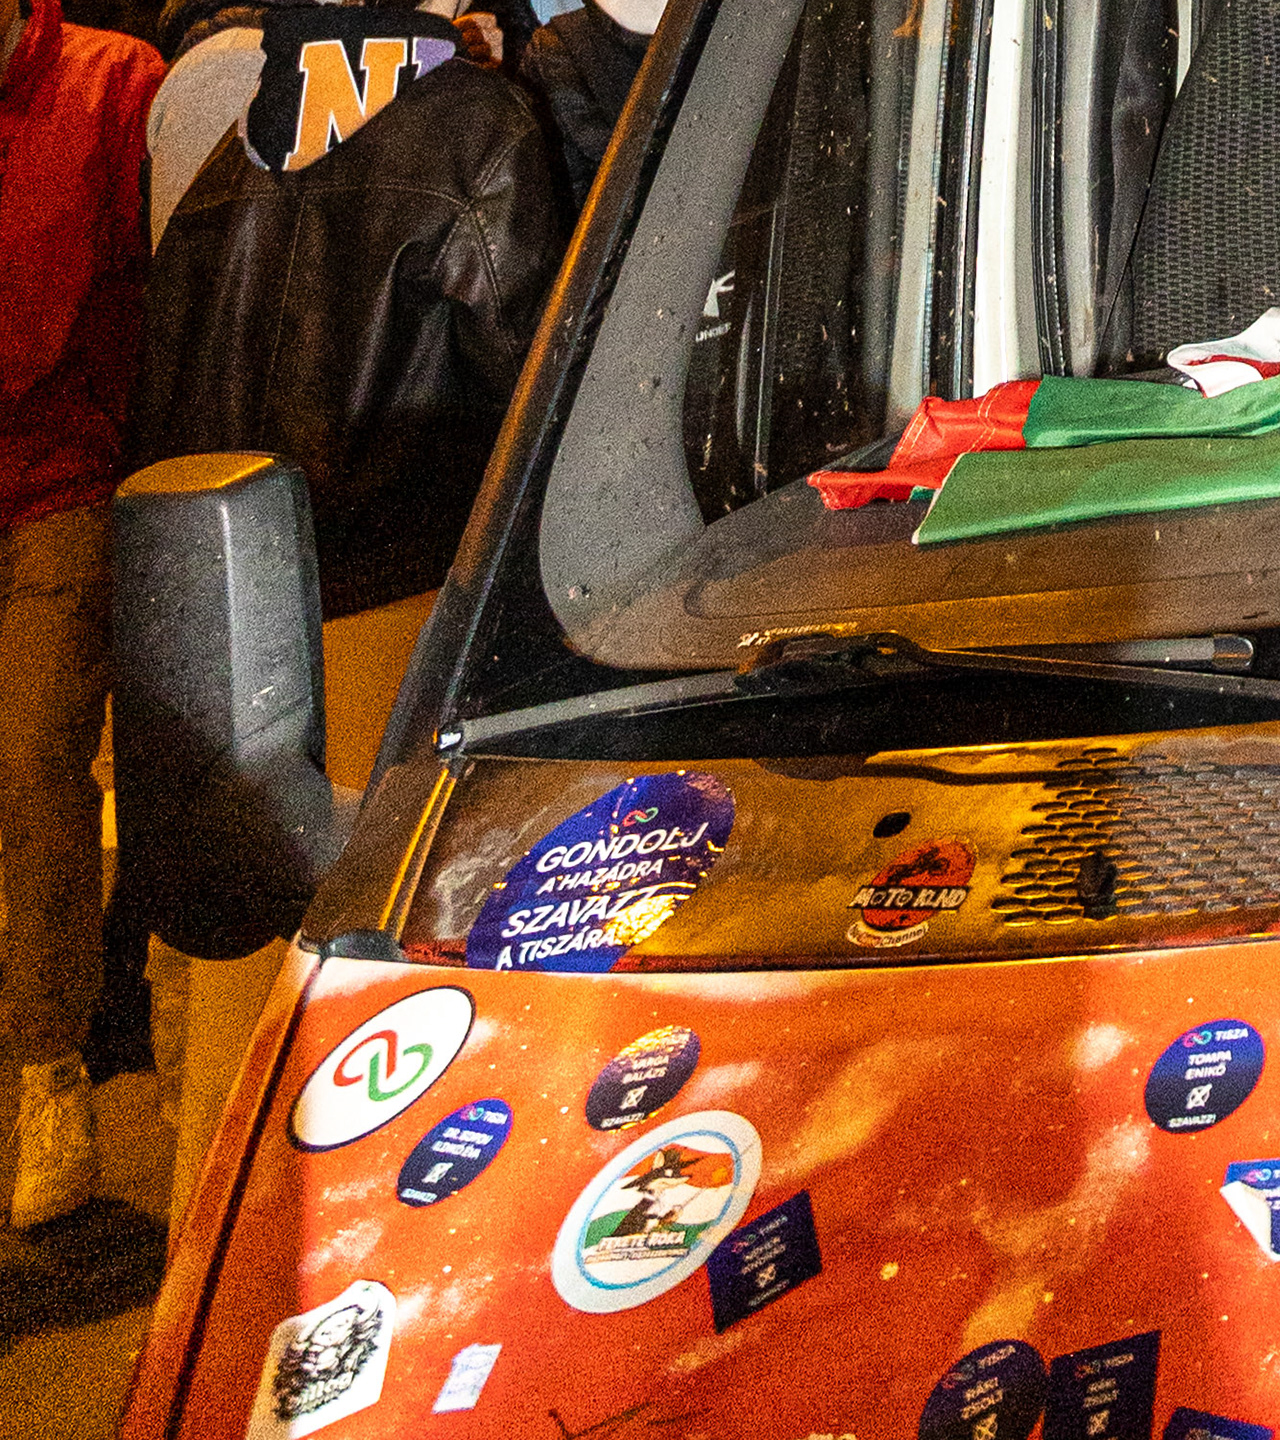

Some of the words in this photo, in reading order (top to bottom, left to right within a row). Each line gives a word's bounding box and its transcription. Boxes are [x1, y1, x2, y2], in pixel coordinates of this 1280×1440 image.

[536, 822, 708, 873] GONDOLJ
[557, 858, 663, 891] HAZÁDRA
[849, 888, 913, 908] MOTO
[495, 946, 512, 971] A
[517, 924, 617, 964] TISZÁRA
[1215, 1028, 1248, 1042] TISZA
[1188, 1050, 1232, 1065] TOMPA
[1168, 1113, 1216, 1128] SZAVAZZ!
